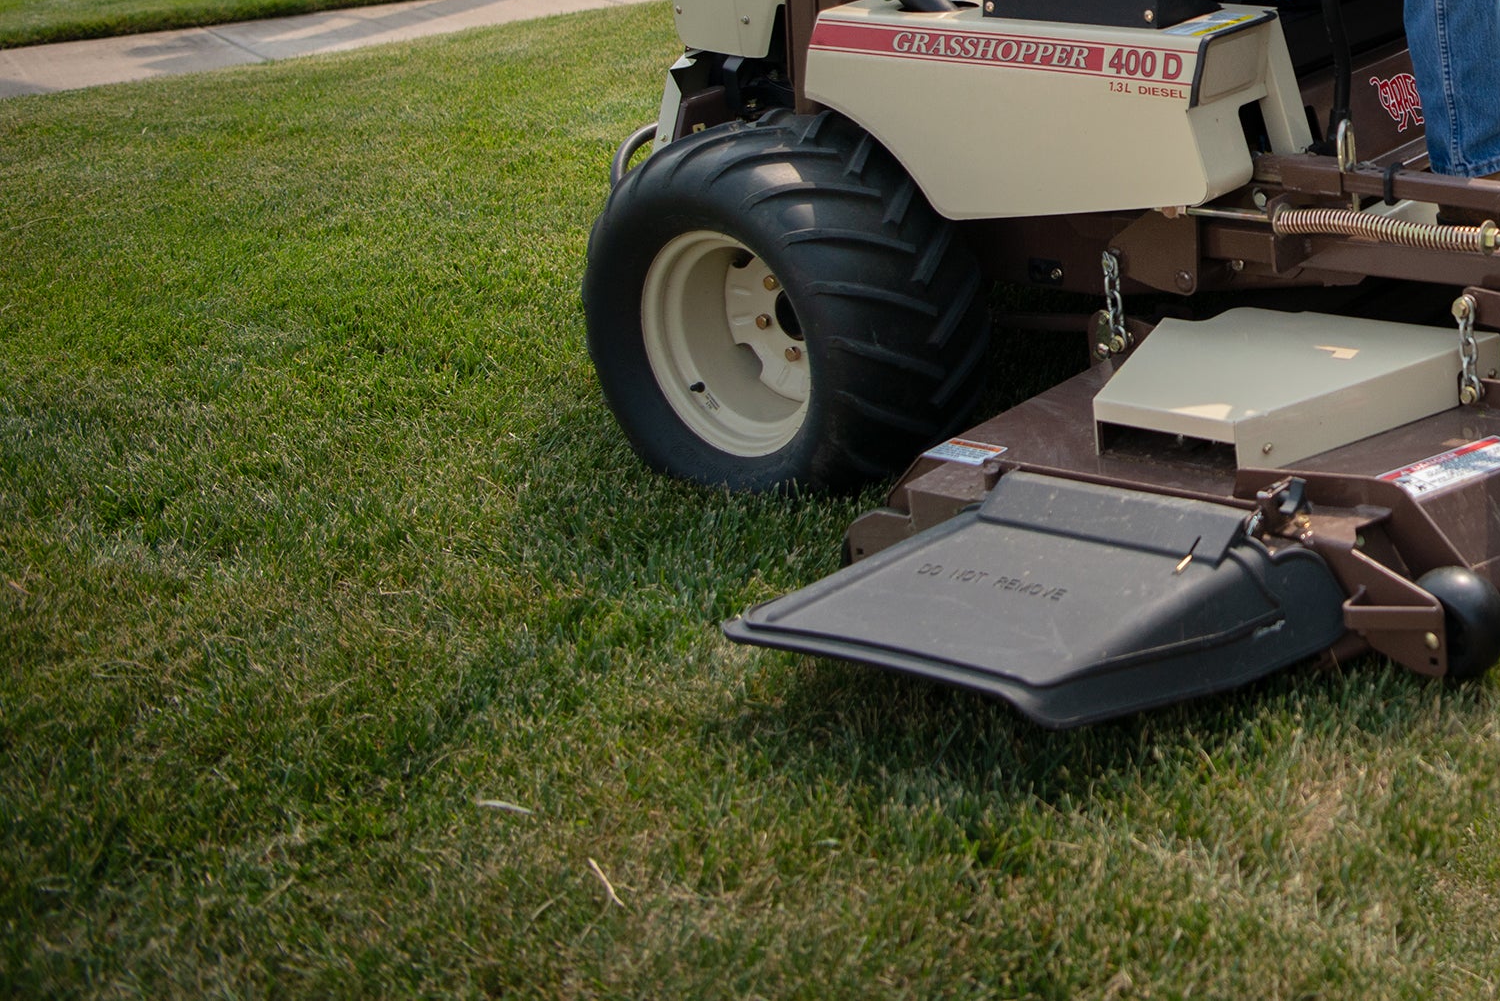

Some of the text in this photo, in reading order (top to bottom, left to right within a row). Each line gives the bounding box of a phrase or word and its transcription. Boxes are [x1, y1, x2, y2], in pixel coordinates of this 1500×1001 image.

[892, 31, 1183, 80] GRASSHOPPER 400 D
[1138, 85, 1187, 99] DIESEL
[917, 562, 1068, 601] DO NOT REMOVE
